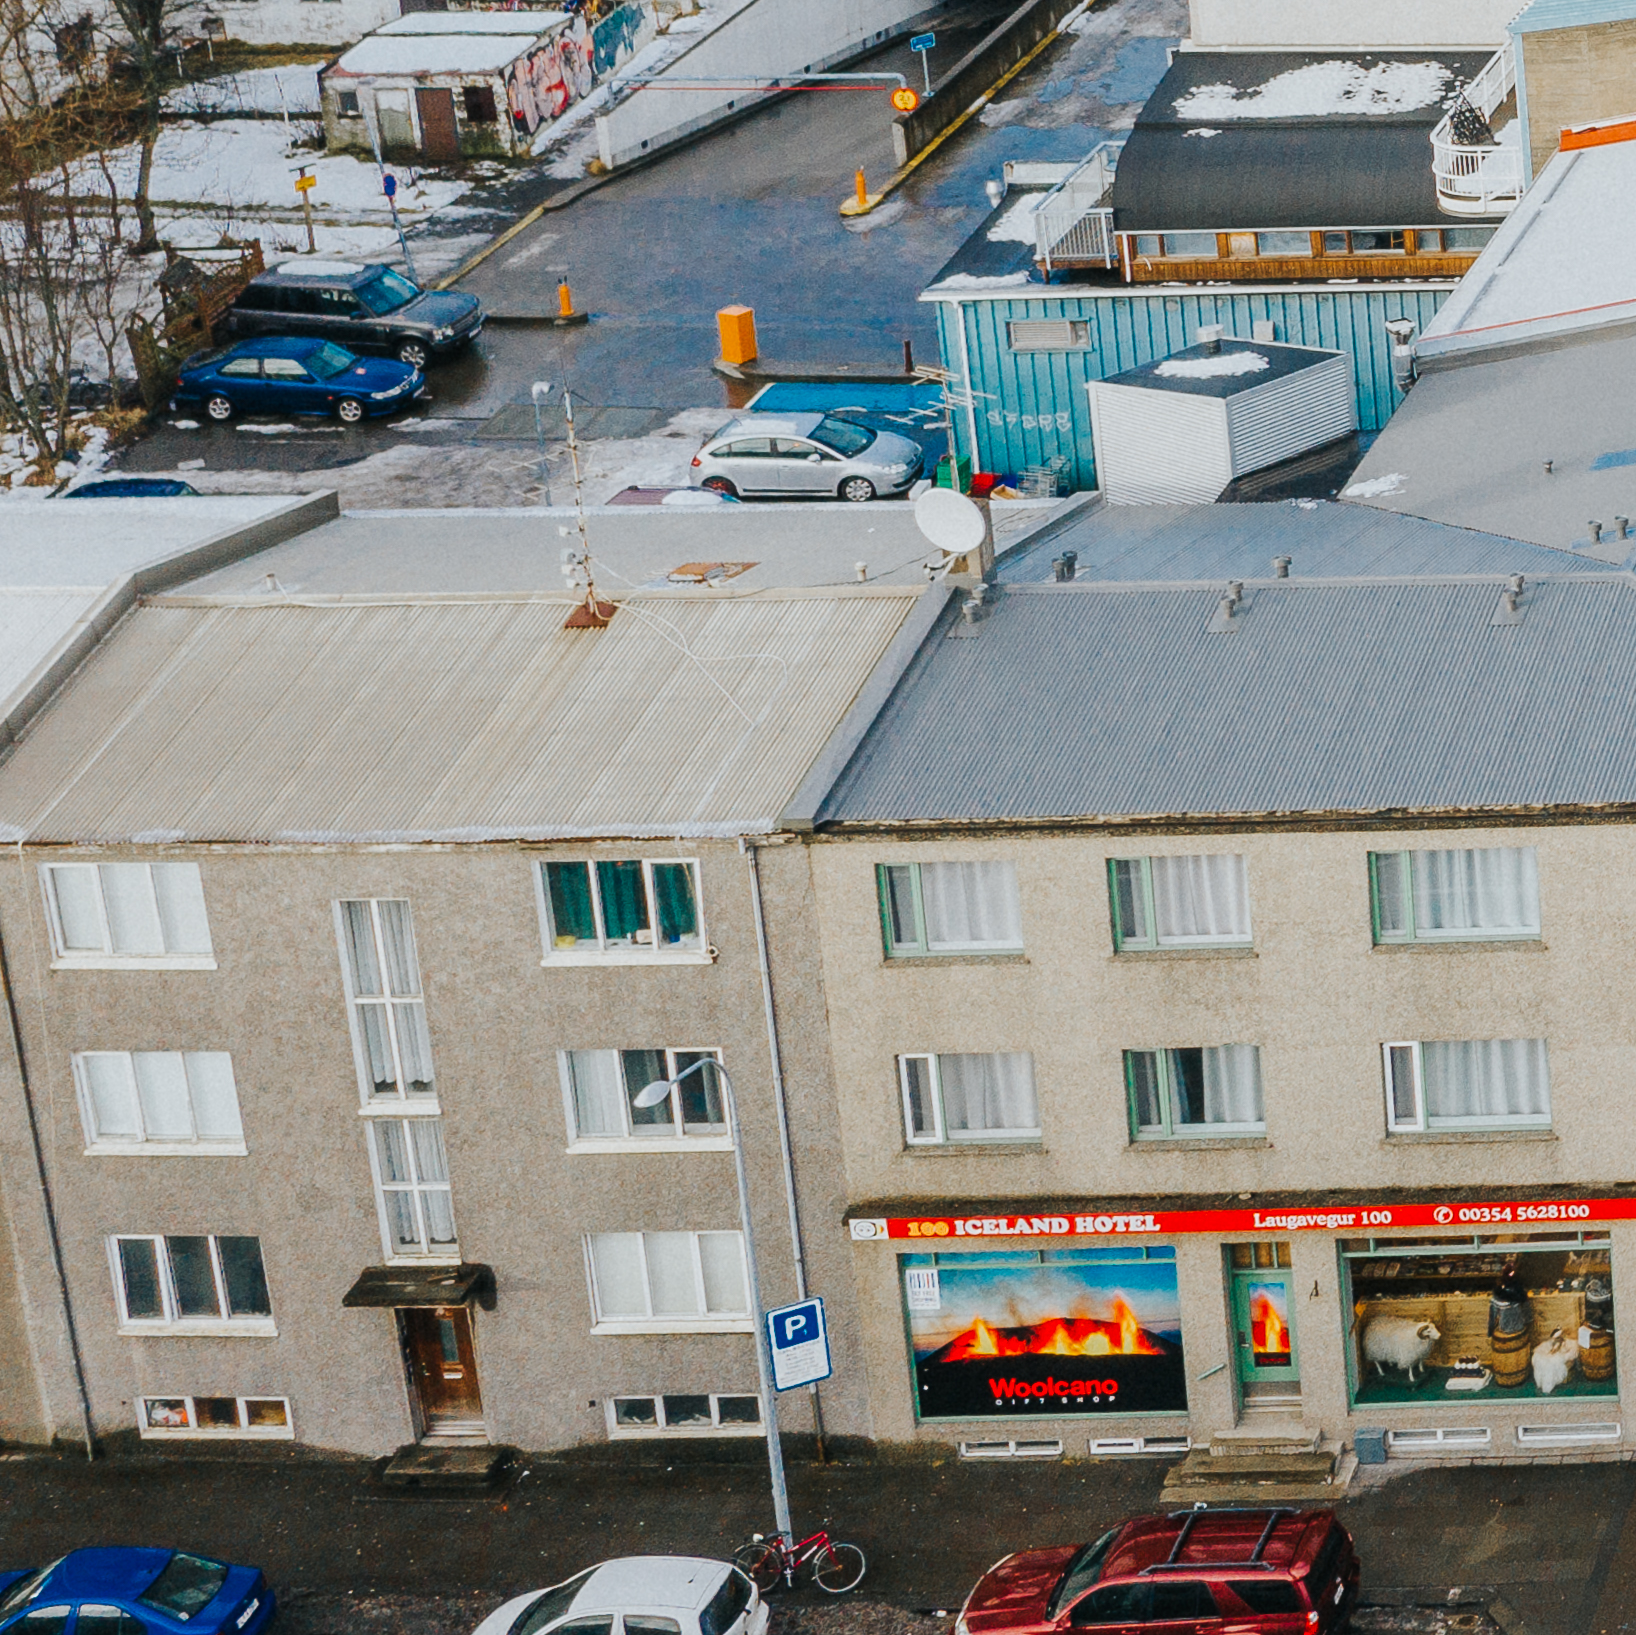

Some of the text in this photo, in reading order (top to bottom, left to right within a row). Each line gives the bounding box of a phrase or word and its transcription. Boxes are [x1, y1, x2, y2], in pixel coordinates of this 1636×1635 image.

[907, 1214, 1161, 1237] 100 ICELAND HOTEL
[1252, 1204, 1590, 1230] Laugavegur 100 00354 5628100
[784, 1314, 807, 1341] P
[988, 1376, 1119, 1398] Woolcano
